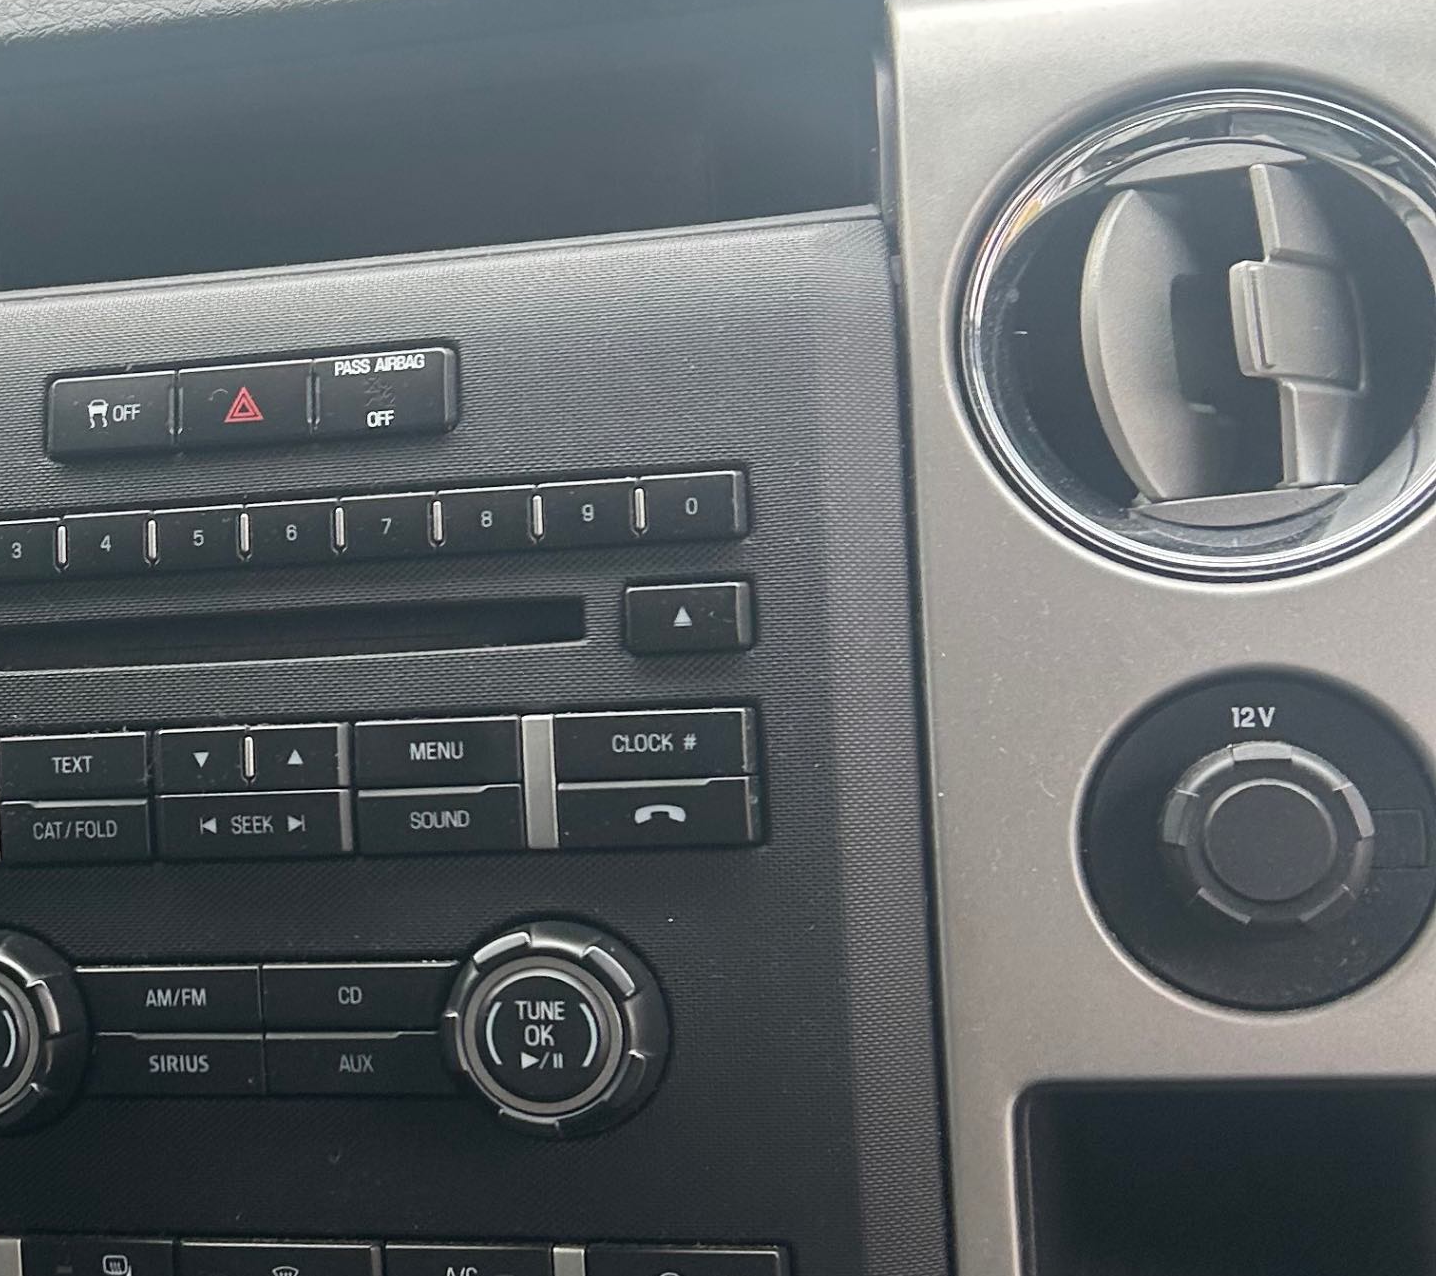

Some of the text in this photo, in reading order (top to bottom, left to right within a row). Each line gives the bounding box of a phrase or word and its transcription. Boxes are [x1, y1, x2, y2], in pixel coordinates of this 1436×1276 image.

[333, 352, 426, 376] PASS AIRBAG
[112, 402, 141, 423] OFF
[366, 408, 396, 429] OFF
[581, 503, 594, 522] 9
[685, 497, 698, 516] 0
[380, 518, 393, 535] 7
[480, 509, 493, 529] 8
[99, 534, 112, 553] 4
[192, 529, 205, 548] 5
[285, 524, 298, 542] 6
[11, 541, 23, 560] 3
[1230, 705, 1276, 729] 12V
[409, 740, 464, 762] MENU
[611, 731, 674, 754] CLOCK
[51, 754, 93, 775] TEXT
[32, 818, 118, 842] CAT/FOLD
[230, 814, 275, 836] SEEK
[409, 808, 470, 831] SOUND
[144, 987, 208, 1008] AM/FM
[337, 986, 364, 1006] CD
[514, 999, 567, 1022] TUNE
[523, 1025, 556, 1048] OK
[147, 1054, 211, 1074] SIRIUS
[338, 1054, 375, 1074] AUX
